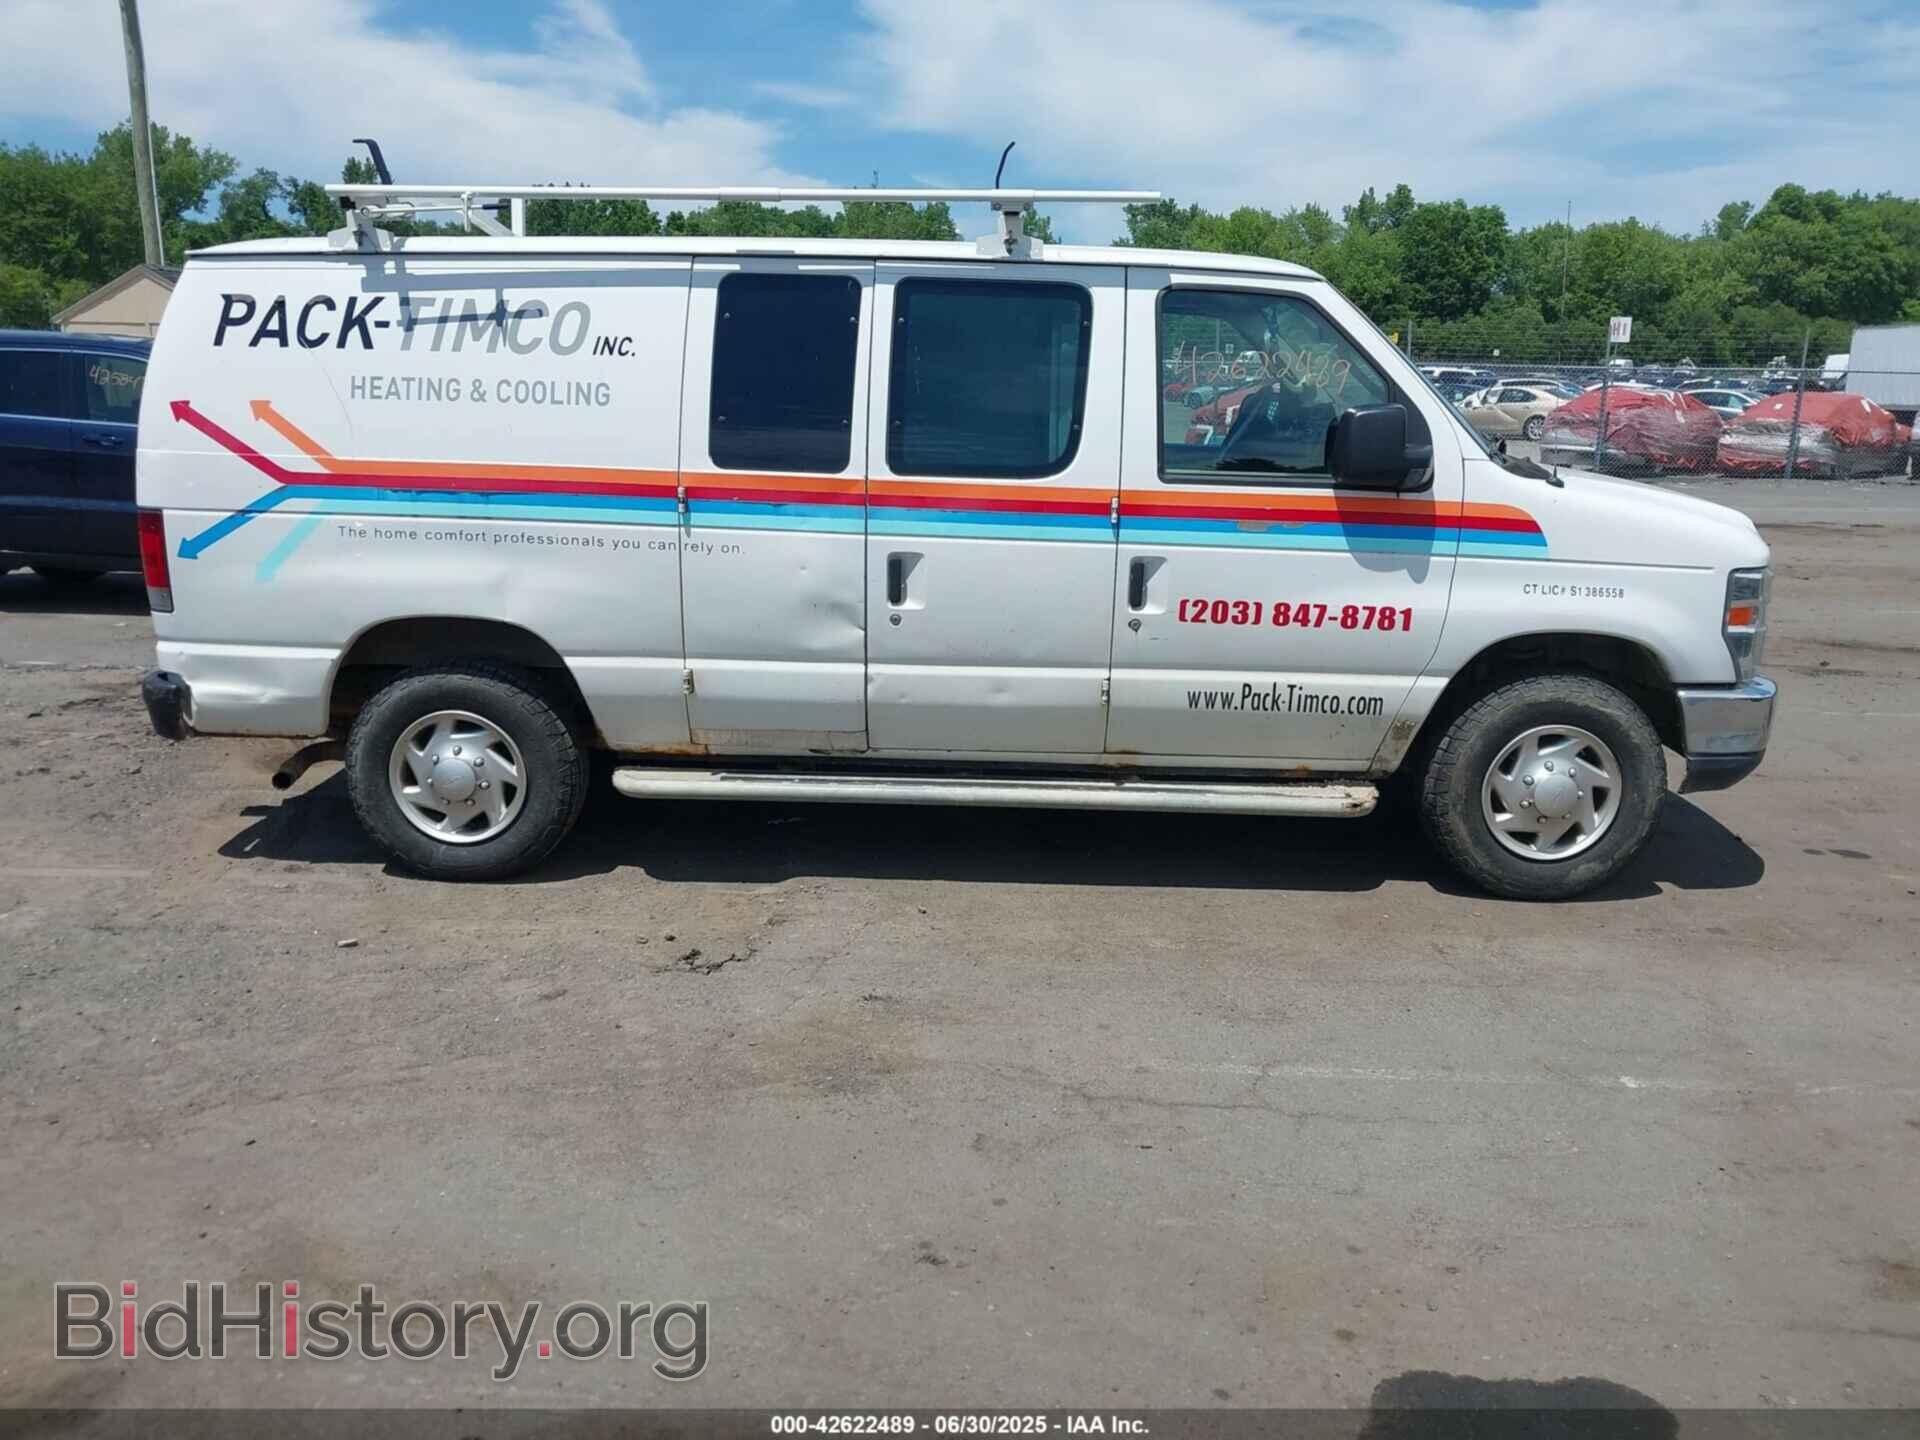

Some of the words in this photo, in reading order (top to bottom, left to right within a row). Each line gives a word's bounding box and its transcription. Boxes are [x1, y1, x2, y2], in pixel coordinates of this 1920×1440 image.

[213, 293, 592, 355] PACK-TIMCO
[593, 335, 637, 357] INC.
[350, 375, 462, 402] HEATING
[470, 380, 488, 403] &
[495, 380, 611, 406] COOLING
[338, 525, 367, 538] The
[374, 527, 418, 540] home
[424, 529, 487, 542] comfort
[493, 532, 605, 548] professionals
[611, 538, 641, 551] you
[648, 539, 677, 551] can
[684, 541, 714, 555] rely
[721, 543, 746, 554] on.
[1523, 584, 1538, 594] CT
[1177, 599, 1263, 625] (203)
[1272, 602, 1413, 632] 847-8781
[1187, 682, 1384, 716] www.Pack-Timco.com
